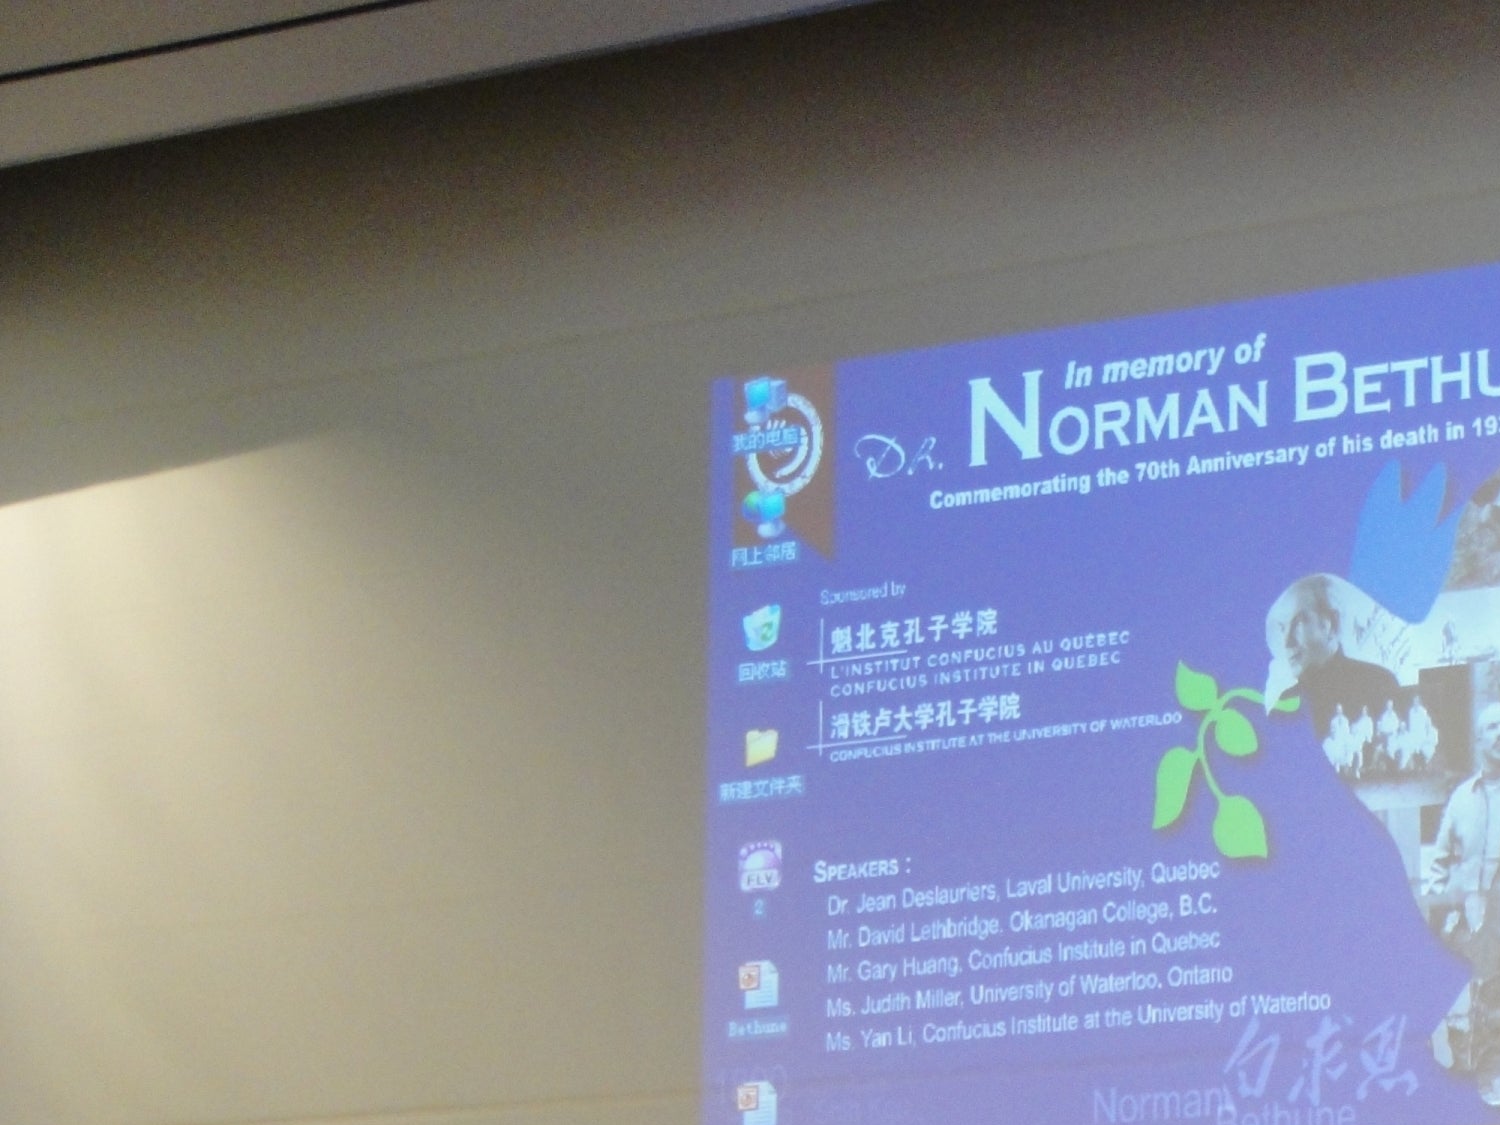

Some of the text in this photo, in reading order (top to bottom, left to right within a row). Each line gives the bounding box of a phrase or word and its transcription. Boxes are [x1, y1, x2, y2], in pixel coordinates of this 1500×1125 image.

[1064, 332, 1267, 389] In memory of
[968, 370, 1268, 467] NORMAN
[929, 475, 1091, 510] Commemorating
[1097, 468, 1129, 488] the
[1136, 459, 1180, 483] 70th
[1187, 443, 1309, 476] Anniversary
[1315, 436, 1336, 459] of
[1343, 431, 1373, 455] his
[1380, 422, 1439, 450] death
[1446, 420, 1465, 441] in
[831, 608, 998, 655] 魁北克孔子学院
[830, 656, 921, 680] L'INSTITUT
[927, 644, 1026, 668] CONFUCIUS
[1033, 640, 1053, 655] AU
[830, 651, 1121, 698] CONFUCIUS INSTITUTE IN QUEBEC
[830, 692, 1021, 740] 滑铁卢大学孔子学院
[969, 733, 986, 748] AT
[988, 730, 1010, 746] THE
[1089, 719, 1108, 733] OF
[1110, 711, 1183, 731] WATERLOO
[746, 871, 774, 886] FLV
[857, 893, 896, 914] Jean
[1006, 873, 1052, 898] Laval
[1057, 866, 1145, 892] University,
[1151, 860, 1220, 884] Quebec
[858, 923, 905, 948] David
[1009, 908, 1098, 932] Okanagan
[1103, 899, 1173, 925] College,
[1179, 892, 1218, 917] B.C.
[857, 959, 897, 983] Gary
[968, 945, 1052, 971] Confucius
[1058, 938, 1125, 962] Institute
[1130, 935, 1146, 955] in
[1151, 931, 1220, 955] Quebec
[826, 998, 856, 1018] Ms.
[861, 991, 911, 1015] Judith
[915, 988, 964, 1010] Miller,
[970, 979, 1054, 1006] University
[1058, 974, 1077, 998] of
[1167, 965, 1233, 988] Ontario
[728, 1020, 787, 1037] Bethune
[861, 1028, 892, 1049] Yan
[923, 1019, 1007, 1044] Confucius
[1011, 1012, 1079, 1036] Institute
[1084, 1010, 1100, 1030] at
[1105, 1007, 1132, 1028] the
[1137, 999, 1224, 1025] University
[1229, 995, 1247, 1018] of
[1251, 991, 1331, 1015] Waterloo
[1093, 1085, 1226, 1125] Norman
